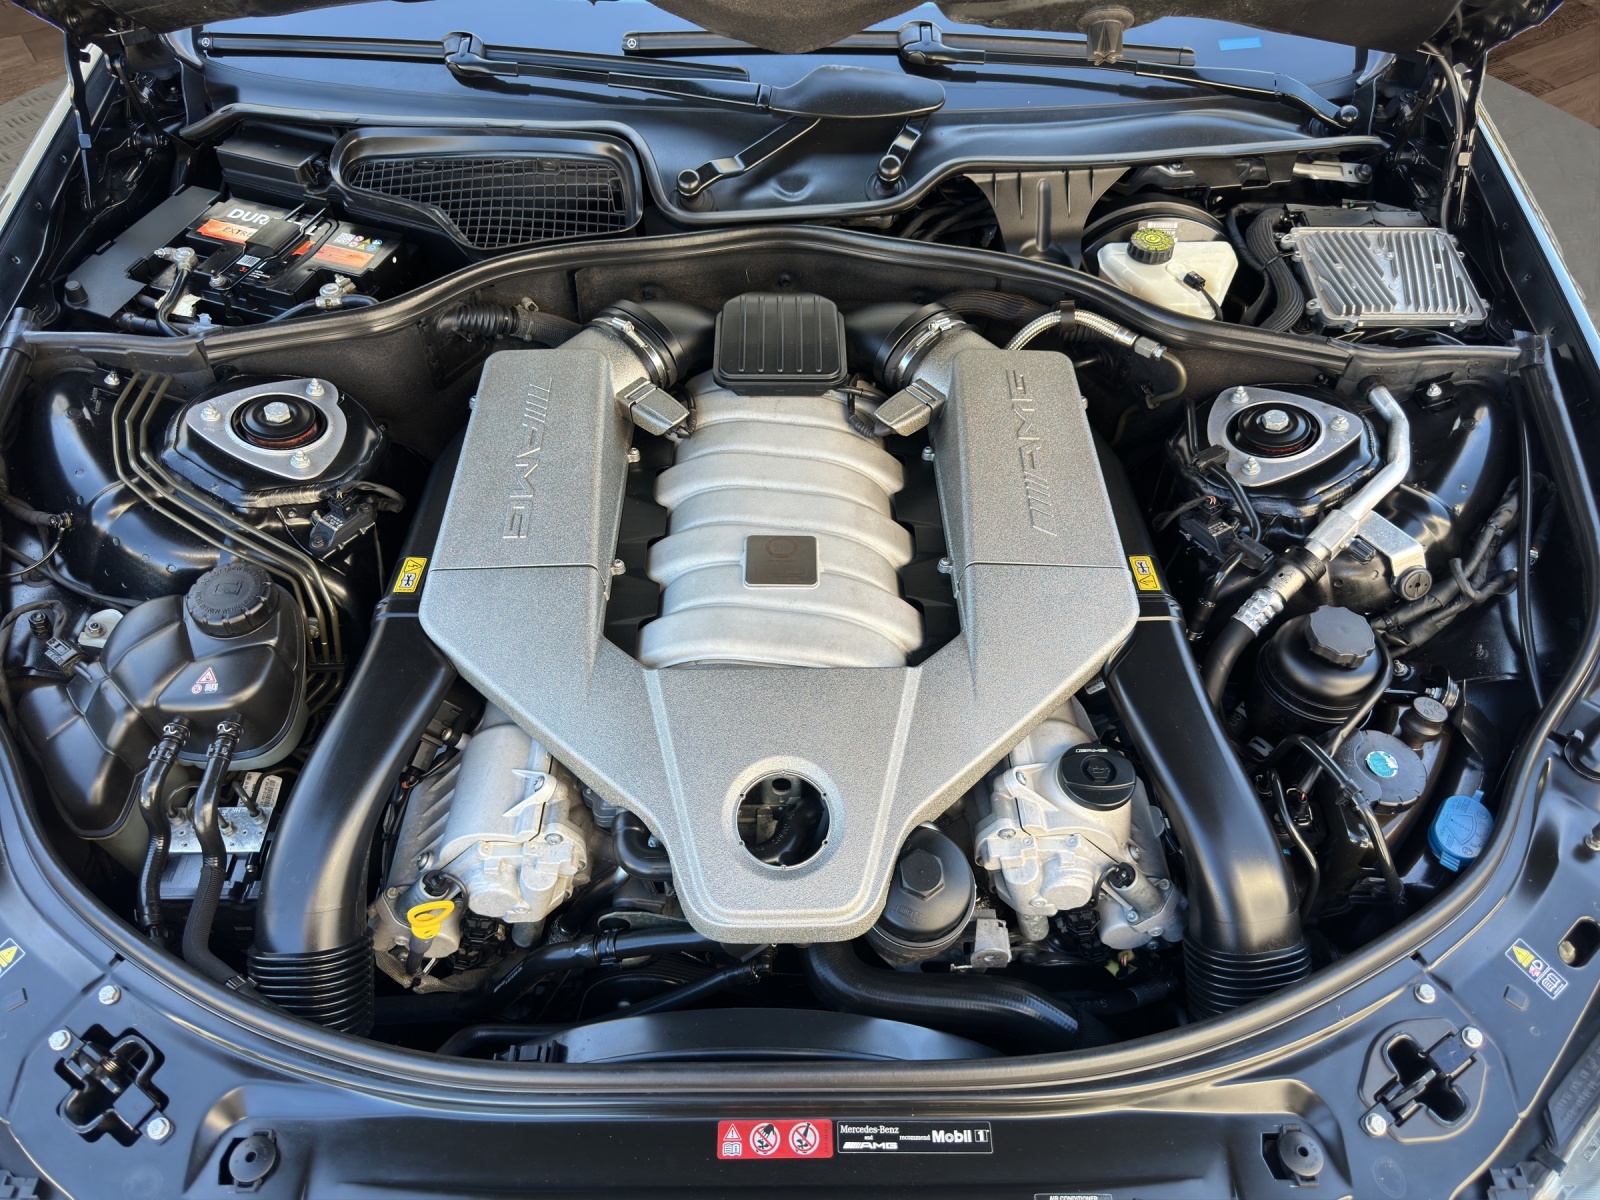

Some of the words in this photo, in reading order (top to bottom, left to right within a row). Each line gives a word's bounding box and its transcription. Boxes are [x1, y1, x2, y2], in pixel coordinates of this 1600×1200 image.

[840, 1124, 899, 1134] Mercedes-Benz
[931, 1129, 972, 1143] Mobil
[860, 1141, 898, 1149] AMG
